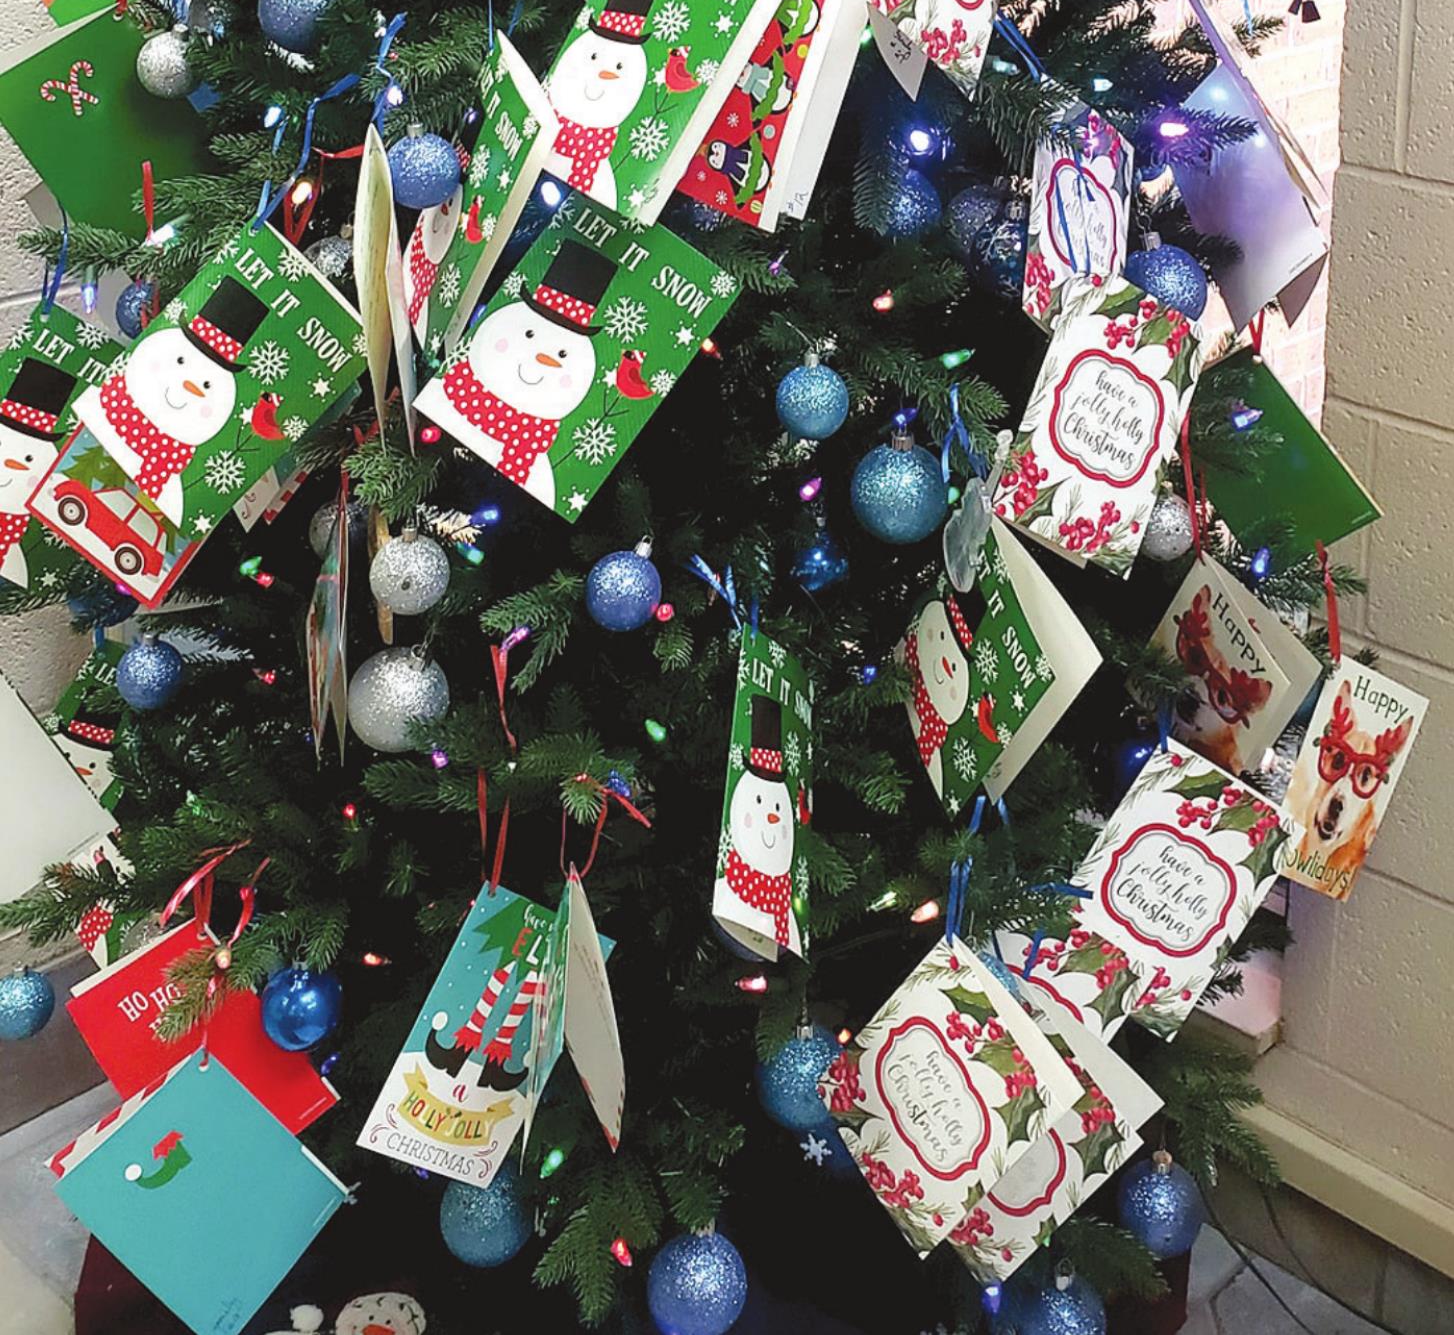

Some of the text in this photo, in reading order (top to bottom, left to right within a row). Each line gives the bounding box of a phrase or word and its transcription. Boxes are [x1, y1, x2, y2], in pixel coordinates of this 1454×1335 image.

[495, 111, 523, 162] SNOW
[573, 207, 712, 318] LET IT SNOW
[235, 248, 353, 373] LET IT SNOW
[32, 328, 106, 384] LET IT
[1095, 369, 1139, 408] have a
[1063, 411, 1136, 471] Christmas
[1069, 391, 1144, 446] jolly holly
[987, 590, 1005, 619] IT
[1002, 626, 1037, 689] SNOW
[1212, 592, 1266, 674] Happy
[95, 662, 118, 687] LE
[752, 658, 774, 693] LET
[779, 677, 791, 706] IT
[1353, 675, 1409, 724] Happy
[1126, 861, 1208, 920] jolly holly
[1159, 844, 1206, 886] have a
[1117, 878, 1194, 942] Christmas
[117, 991, 149, 1022] HO
[452, 1084, 468, 1103] a
[926, 1050, 952, 1094] have
[403, 1091, 495, 1140] HOLLY JOLLY
[888, 1064, 948, 1162] Christmas
[898, 1054, 963, 1146] jolly holly
[386, 1132, 475, 1176] CHRISTMAS
